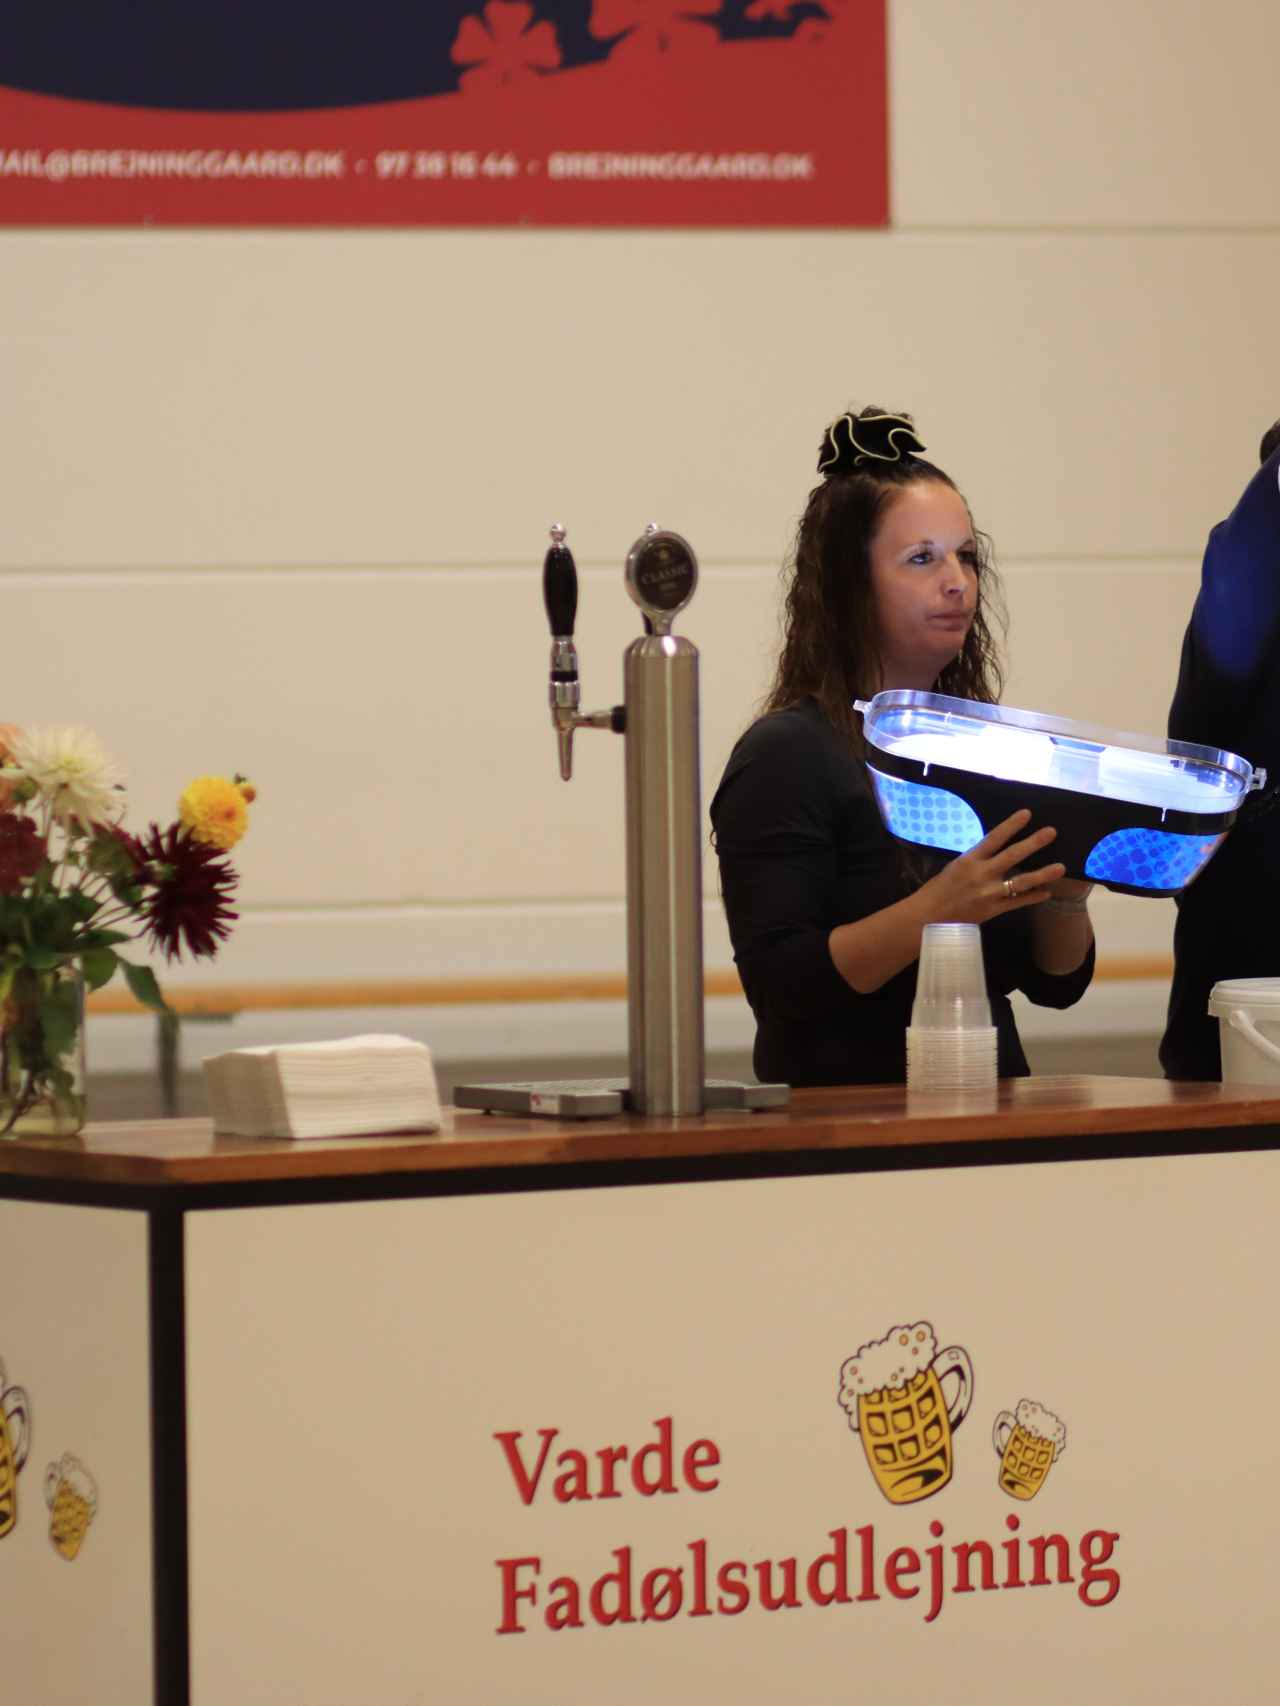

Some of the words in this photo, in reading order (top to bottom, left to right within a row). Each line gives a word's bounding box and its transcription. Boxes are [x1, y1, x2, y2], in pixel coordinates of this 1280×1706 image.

[0, 150, 343, 182] AIL@BREJNINGGAARD.DK
[492, 1415, 721, 1506] Varde
[494, 1513, 1122, 1636] Fadølsudlejning
